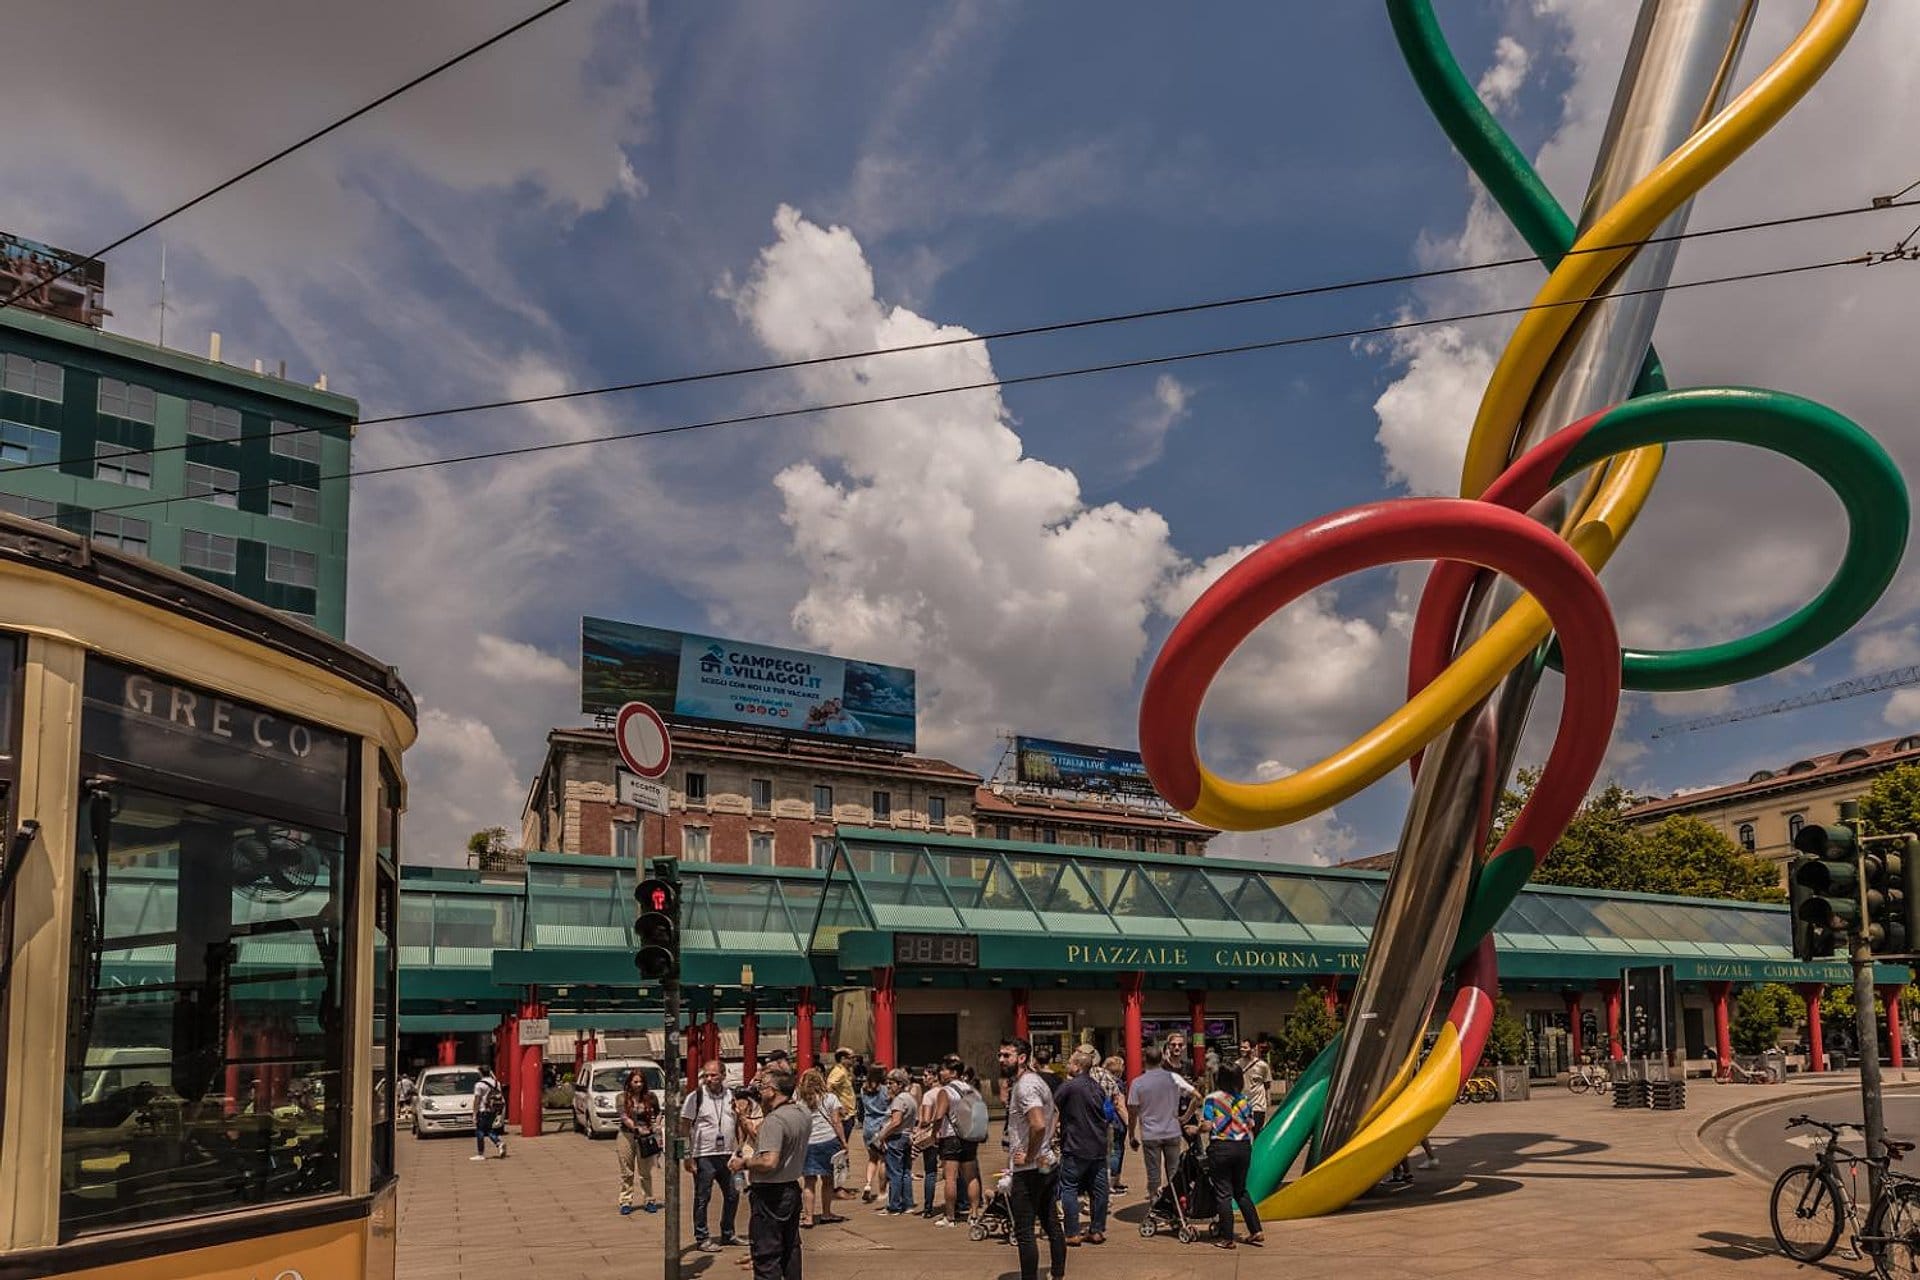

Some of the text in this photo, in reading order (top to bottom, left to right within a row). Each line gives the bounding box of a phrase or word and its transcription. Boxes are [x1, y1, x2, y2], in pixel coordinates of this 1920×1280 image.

[728, 652, 811, 675] CAMPEGGI
[724, 665, 822, 689] &VILLAGGI.IT
[124, 674, 312, 758] GRECO
[1058, 757, 1085, 768] ITALIA
[1086, 759, 1106, 770] LIVE
[1067, 944, 1189, 966] PIAZZALE
[1215, 948, 1320, 969] CADORNA
[1696, 962, 1752, 977] PIAZZALE
[1763, 964, 1814, 979] CADORNA
